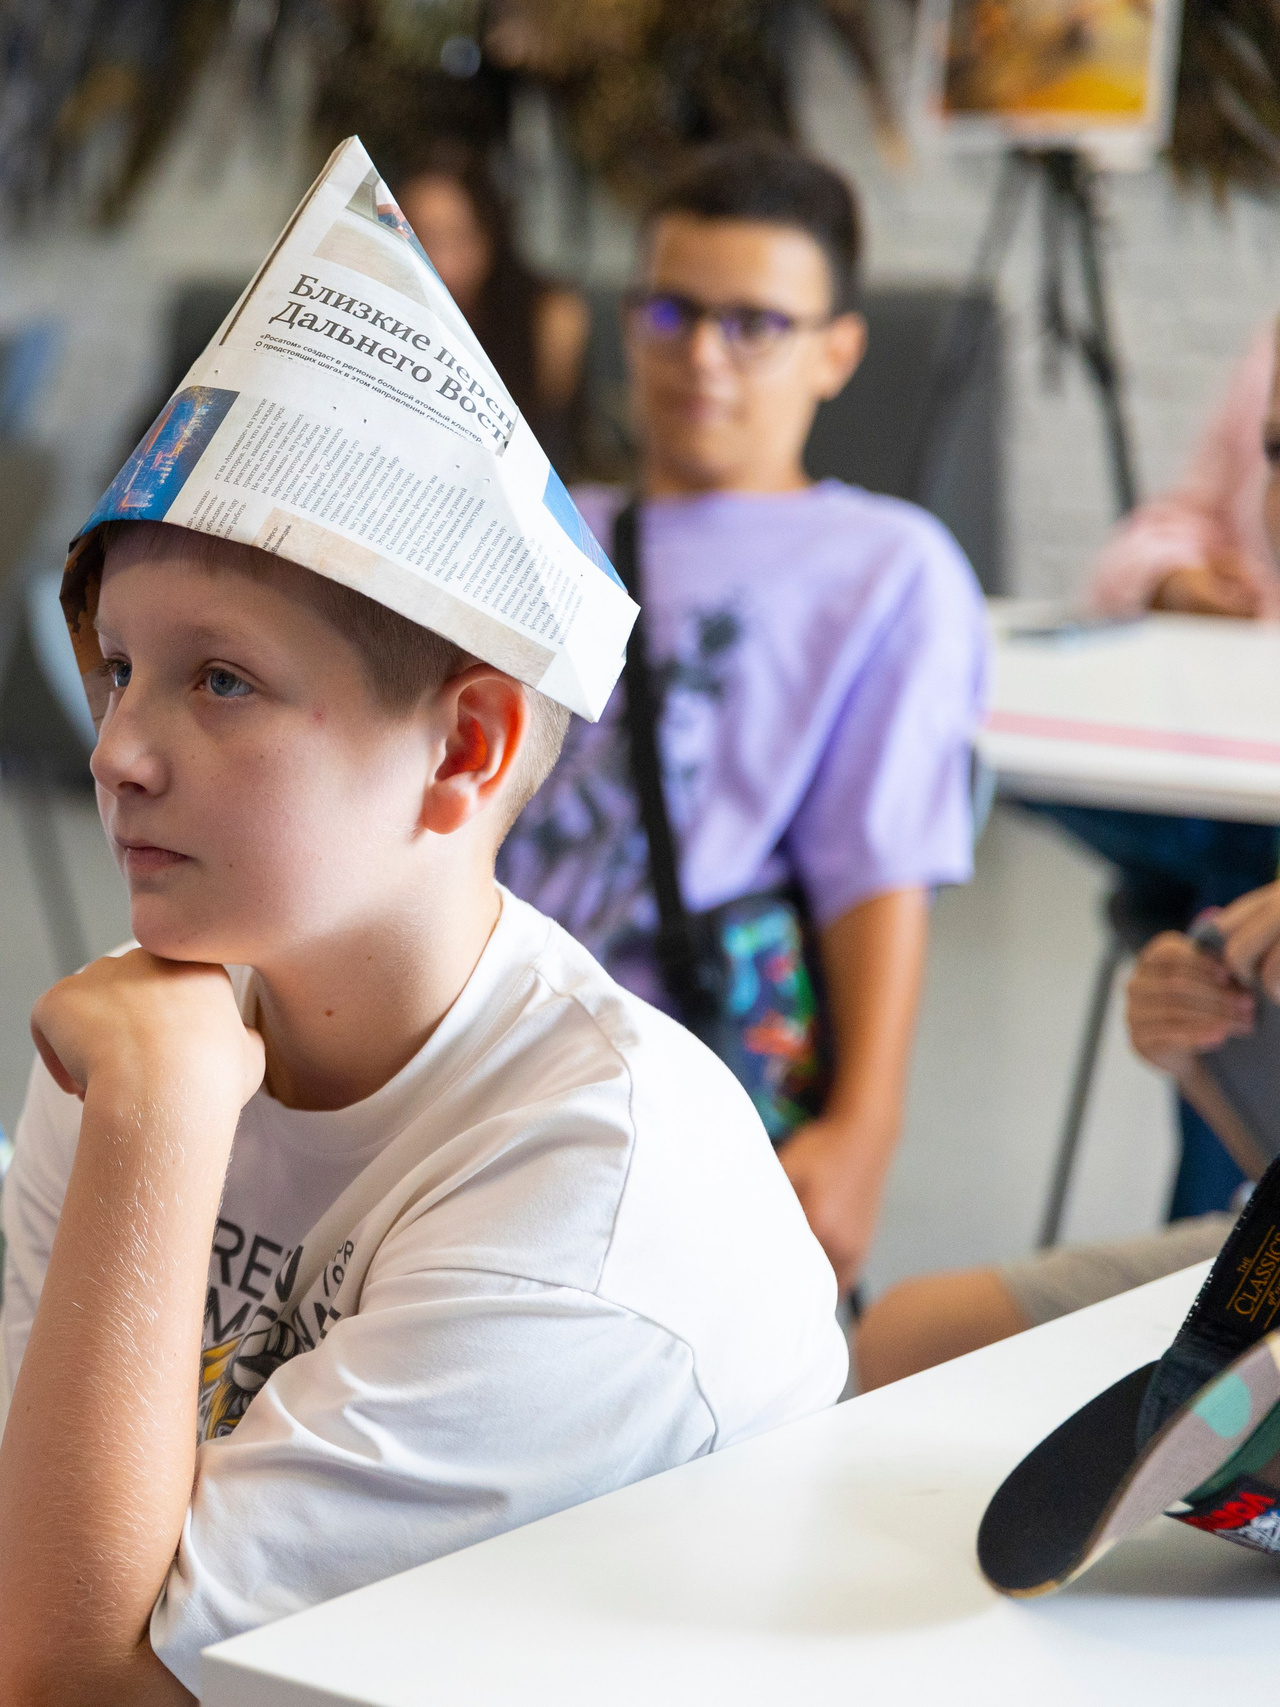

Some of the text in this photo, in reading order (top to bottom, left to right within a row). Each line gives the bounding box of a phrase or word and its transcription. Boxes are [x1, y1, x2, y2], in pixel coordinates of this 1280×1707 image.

[268, 301, 432, 383] Дальнего
[289, 274, 431, 351] Близкие
[260, 334, 301, 349] «Росатом»
[303, 346, 335, 361] создаст
[342, 362, 376, 381] регионе
[377, 378, 415, 401] большой
[415, 399, 451, 421] атомный
[451, 420, 484, 444] кластер.
[263, 343, 317, 363] предстоящих
[317, 360, 343, 375] шагах
[351, 375, 371, 388] этом
[371, 385, 426, 416] направлении
